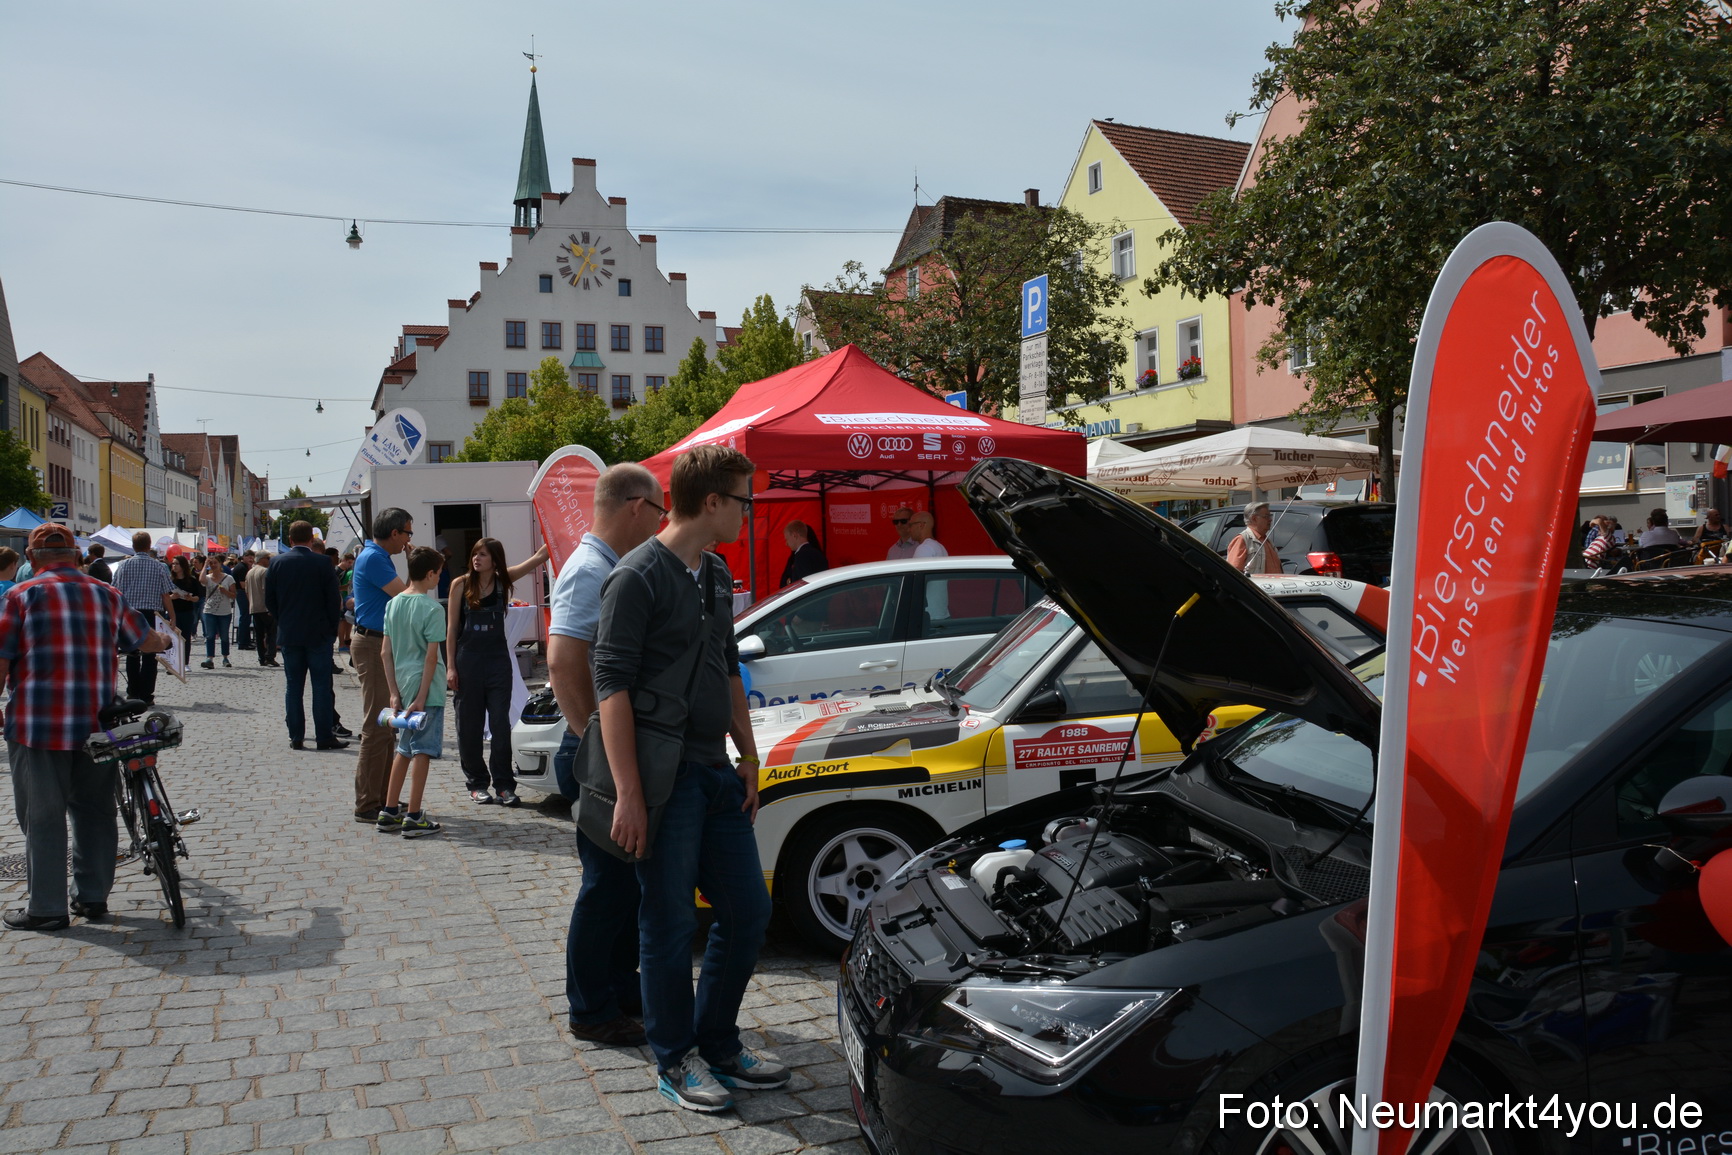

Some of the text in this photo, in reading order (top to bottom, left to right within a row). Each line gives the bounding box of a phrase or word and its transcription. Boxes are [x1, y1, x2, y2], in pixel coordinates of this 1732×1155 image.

[1028, 285, 1042, 329] P
[1023, 350, 1045, 361] Parkschein
[831, 415, 974, 425] Bierschneider
[382, 438, 401, 456] LANG
[1272, 449, 1315, 461] Tucher
[1096, 467, 1130, 478] Tucher
[1413, 289, 1548, 665] Bierschneider
[1437, 515, 1504, 685] Menschen
[1501, 442, 1527, 504] und
[1521, 347, 1560, 432] Autos
[1060, 728, 1088, 738] 1985
[1037, 746, 1075, 758] RALLYE
[1077, 741, 1128, 754] SANREMO
[766, 761, 849, 781] Audi Sport
[898, 778, 982, 799] MICHELIN
